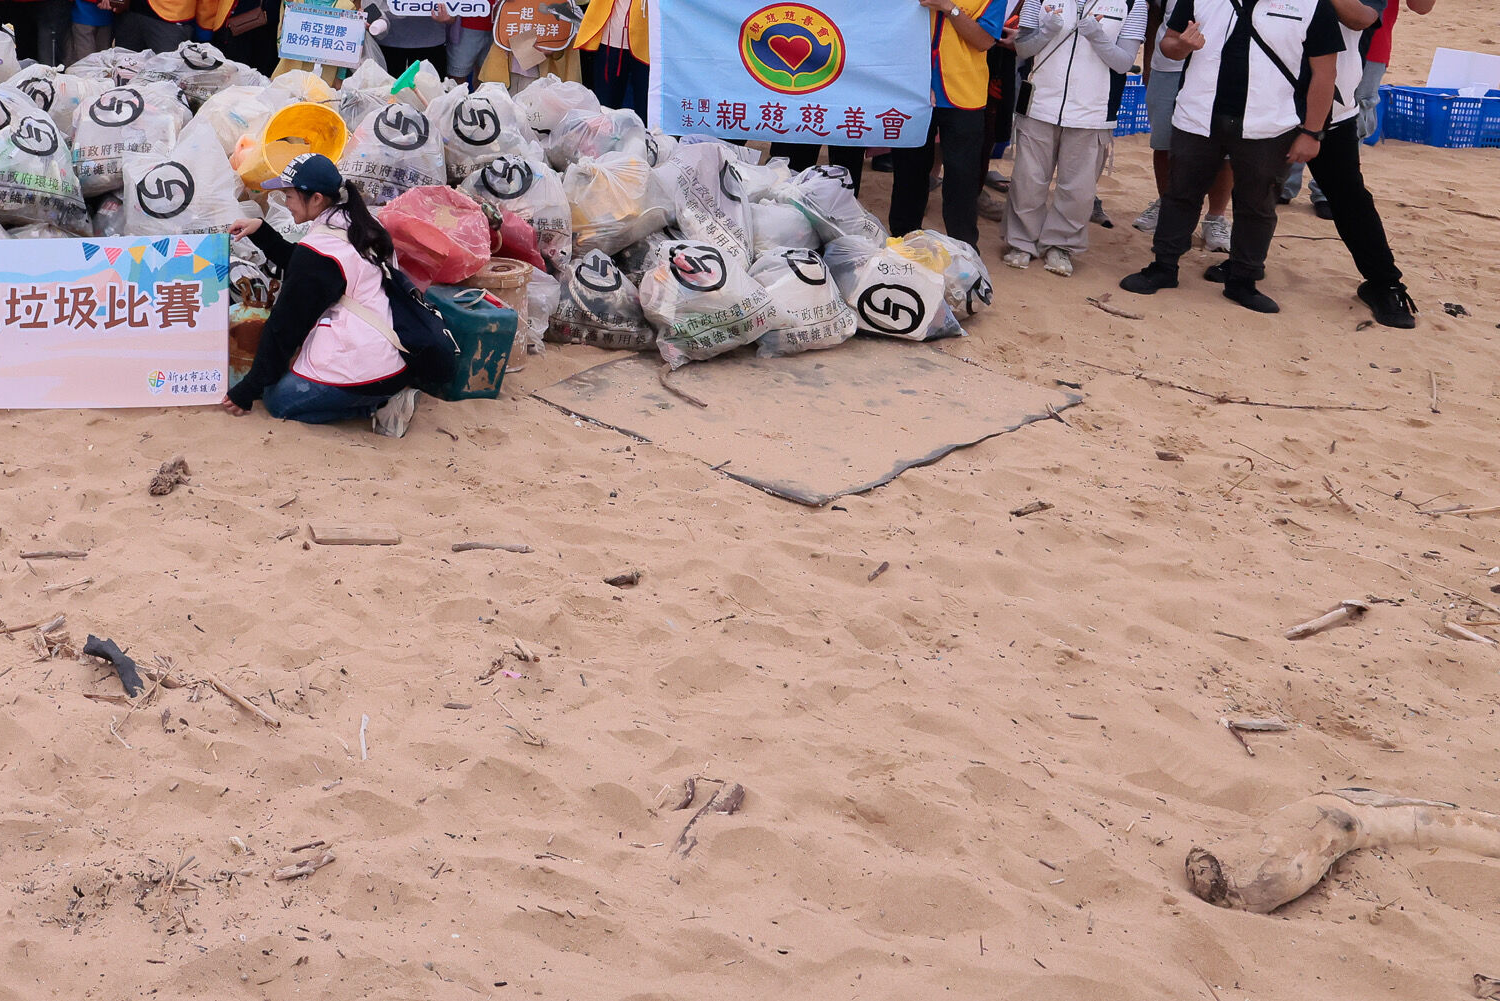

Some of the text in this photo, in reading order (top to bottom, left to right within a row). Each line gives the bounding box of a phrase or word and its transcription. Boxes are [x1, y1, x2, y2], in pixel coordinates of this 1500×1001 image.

[507, 7, 534, 21] 一起
[300, 21, 348, 38] 南亞塑膠
[286, 32, 357, 54] 股份有限公司
[681, 98, 710, 113] 社團
[681, 114, 712, 128] 法人
[715, 99, 913, 140] 親慈慈善會
[167, 369, 221, 383] 新北市政府
[171, 383, 217, 394] 環境保護局
